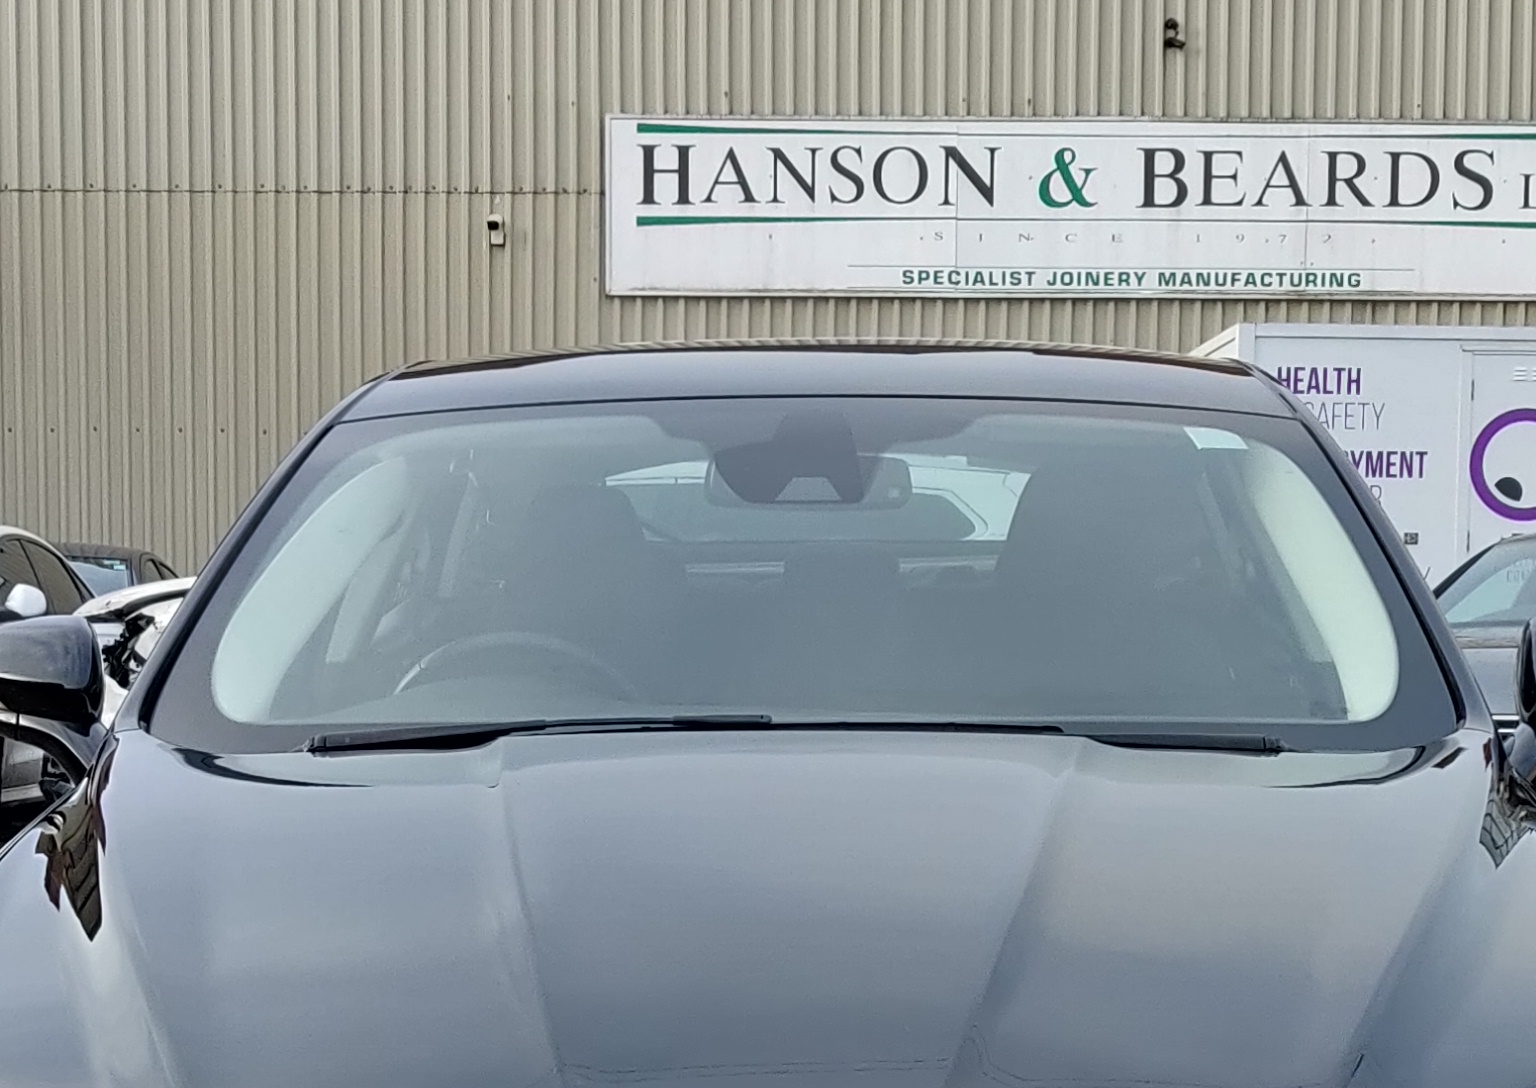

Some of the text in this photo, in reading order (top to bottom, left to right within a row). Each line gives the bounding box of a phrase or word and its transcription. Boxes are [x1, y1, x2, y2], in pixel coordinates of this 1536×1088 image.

[636, 143, 1003, 207] HANSON
[1038, 147, 1099, 209] &
[1136, 147, 1496, 211] BEARDS
[901, 269, 1363, 289] SPECIALIST JOINERY MANUFACTURING
[1277, 366, 1362, 395] HEALTH
[1303, 402, 1386, 430] AFETY
